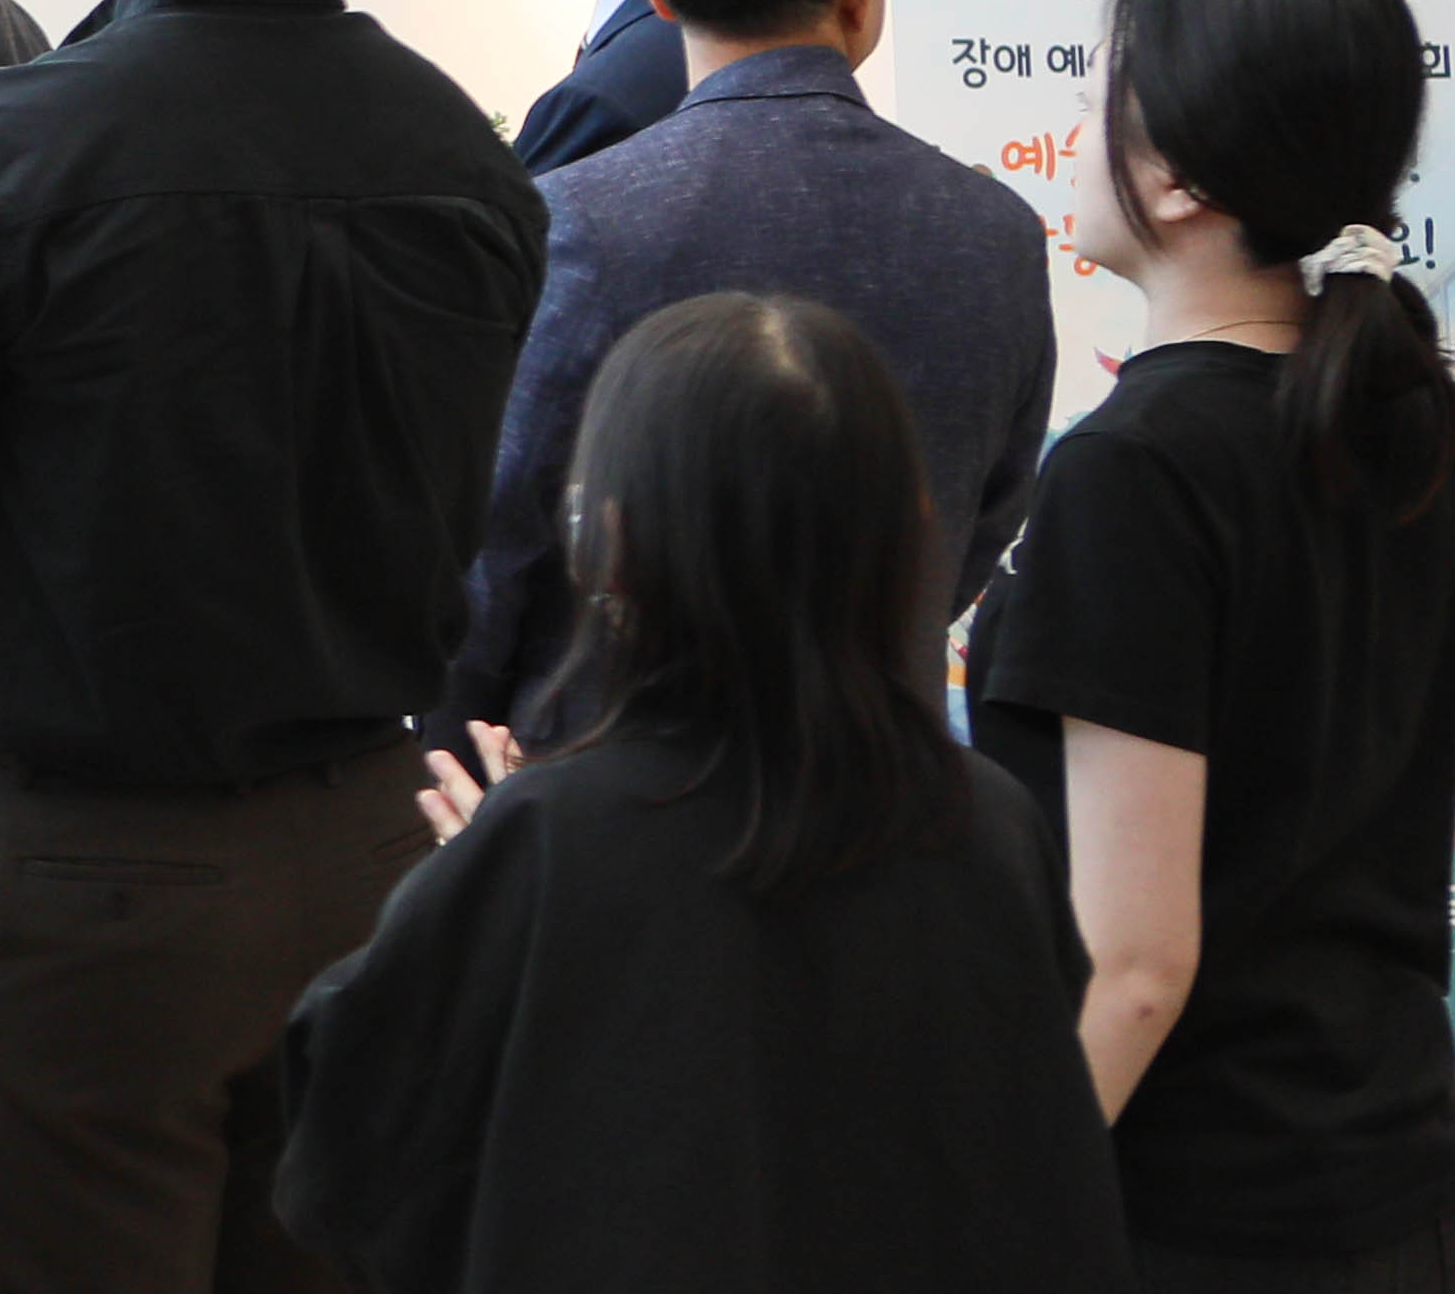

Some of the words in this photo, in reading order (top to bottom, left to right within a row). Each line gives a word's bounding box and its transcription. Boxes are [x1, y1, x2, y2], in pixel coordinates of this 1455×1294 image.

[951, 37, 1032, 89] 장애
[1046, 43, 1090, 79] 예
[1388, 216, 1437, 270] 요!
